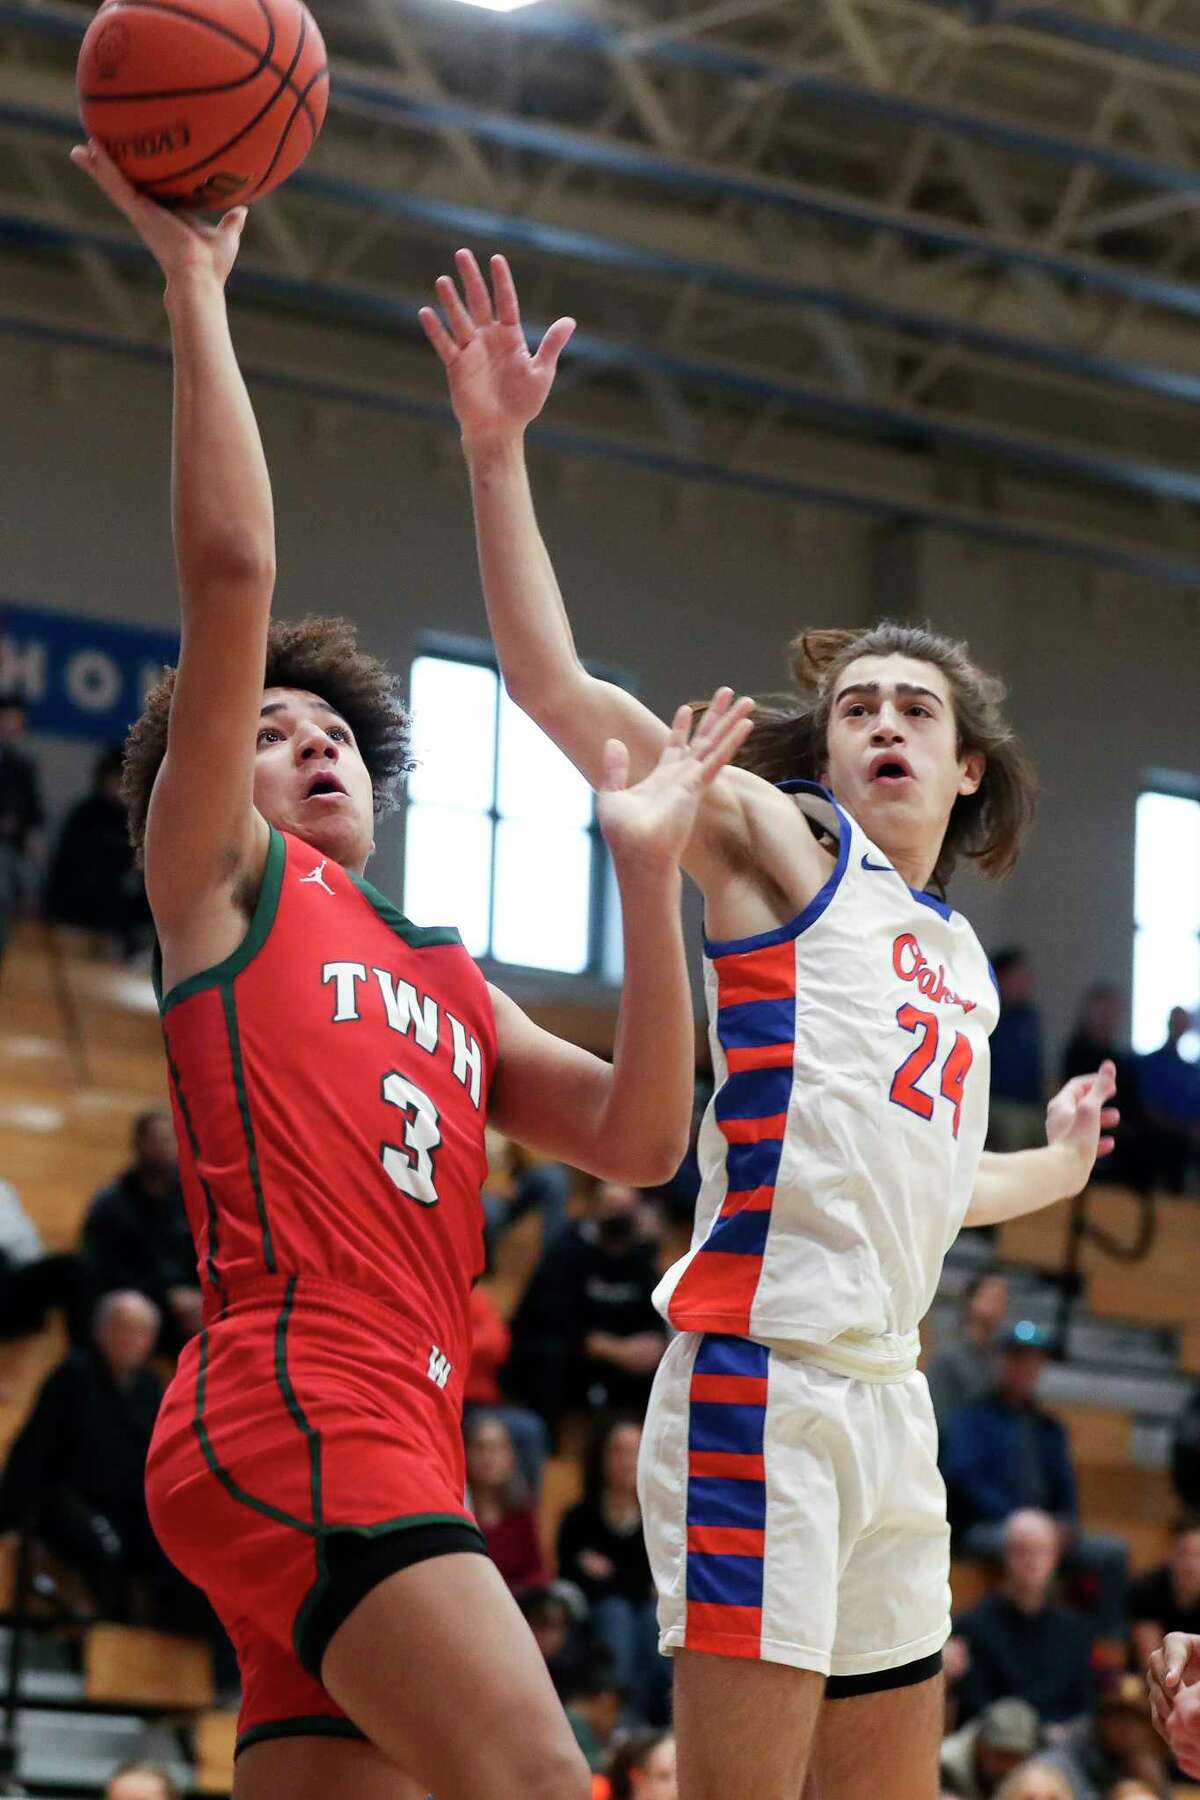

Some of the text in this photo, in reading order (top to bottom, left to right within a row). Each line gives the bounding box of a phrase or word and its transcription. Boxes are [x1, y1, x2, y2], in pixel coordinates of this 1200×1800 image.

[321, 960, 482, 1111] TWH
[889, 1002, 973, 1140] 24
[380, 1067, 443, 1208] 3
[426, 1343, 453, 1391] W
